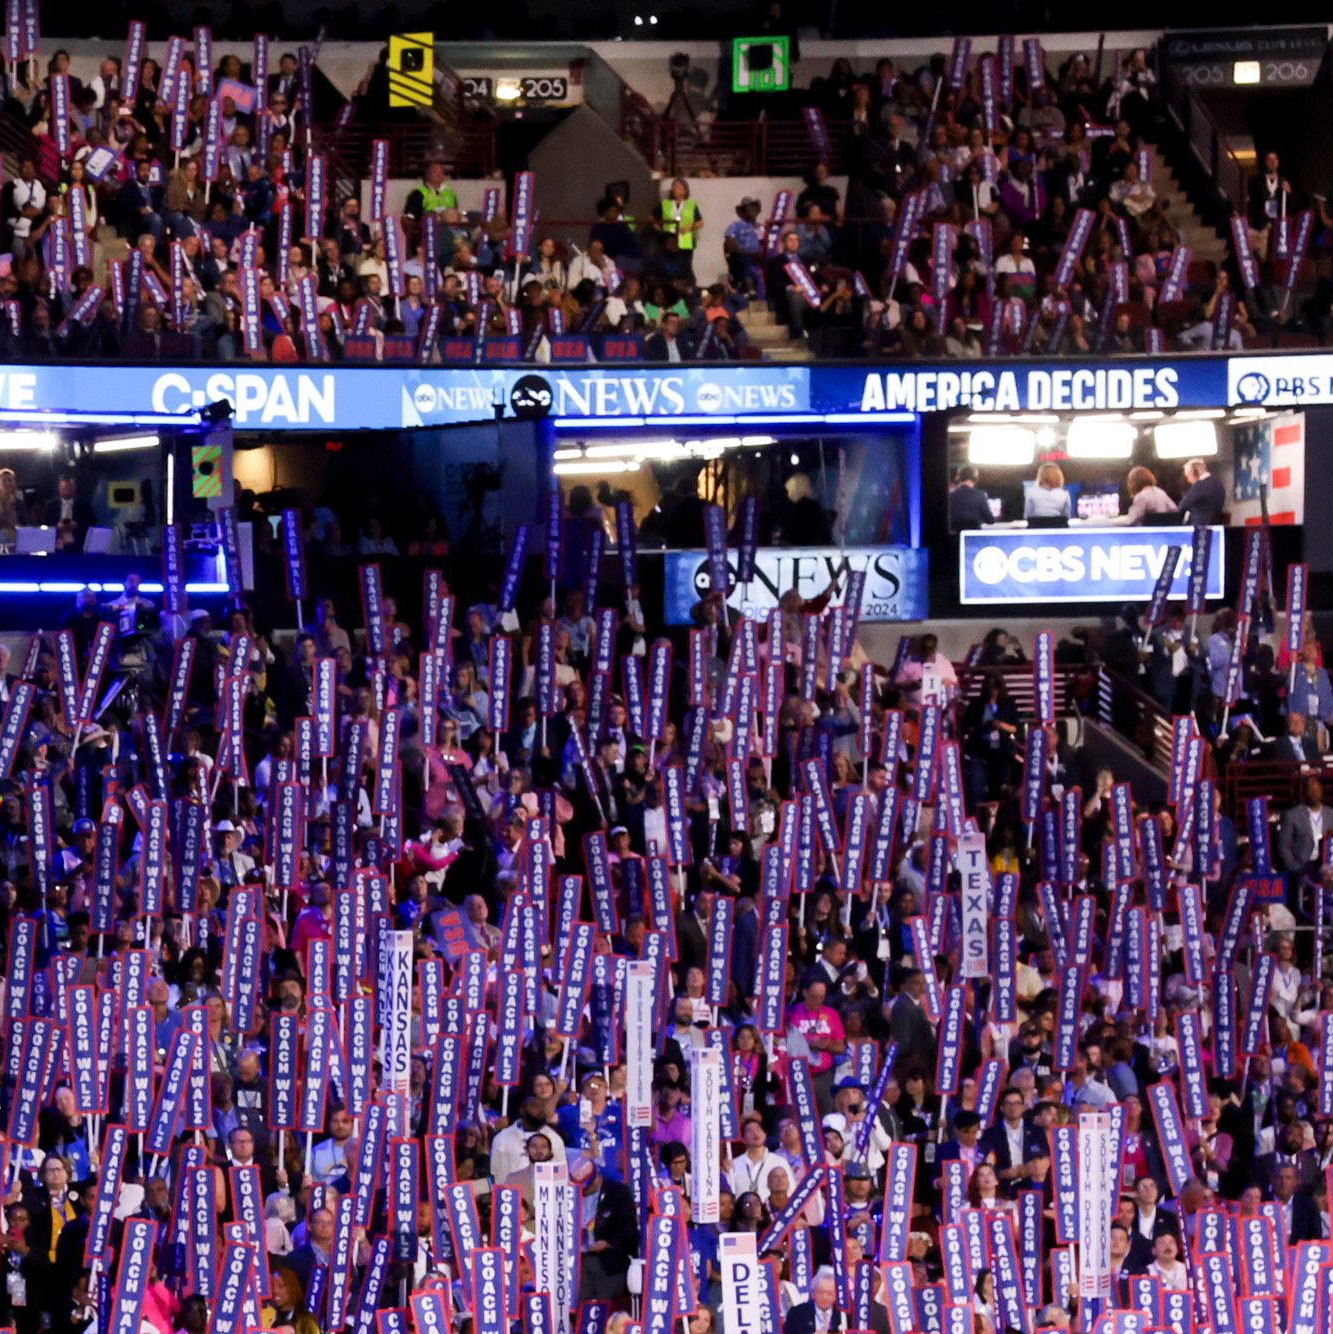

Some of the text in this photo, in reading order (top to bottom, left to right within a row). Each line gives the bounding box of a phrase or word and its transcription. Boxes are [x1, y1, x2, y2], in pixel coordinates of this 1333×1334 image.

[526, 80, 564, 97] 205
[1267, 63, 1307, 80] 206
[556, 377, 684, 416] NEWS
[723, 383, 796, 408] NEWS
[861, 367, 1178, 412] AMERICA DECIDES
[1009, 545, 1192, 581] CBS NEW
[866, 604, 897, 616] 2024
[967, 850, 984, 958] TEXAS
[1183, 888, 1202, 979] COACH WALZ
[396, 950, 407, 1073] KANSAS
[705, 1123, 713, 1196] CAROLINA
[556, 1188, 566, 1333] MINNESOTA
